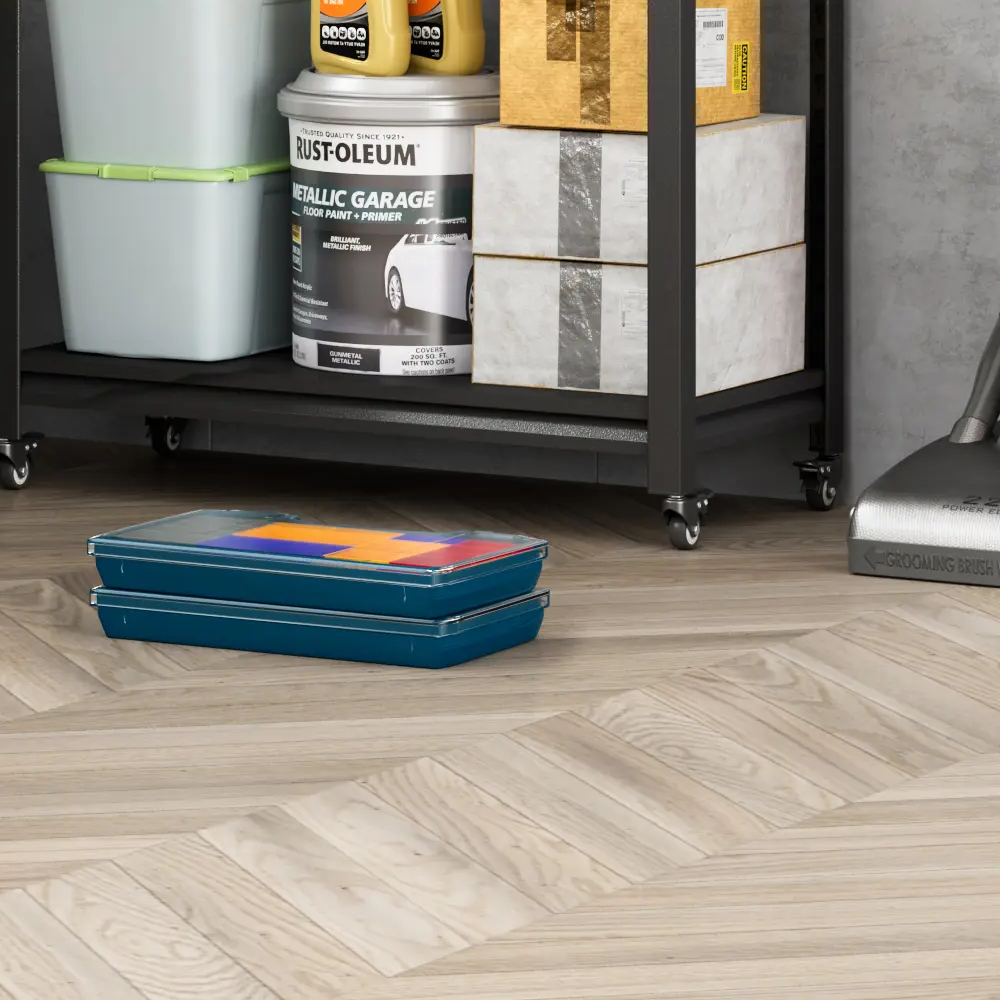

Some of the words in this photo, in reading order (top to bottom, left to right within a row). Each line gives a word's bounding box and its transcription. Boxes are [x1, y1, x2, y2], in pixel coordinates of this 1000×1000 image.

[302, 128, 323, 137] TRUSTED
[325, 131, 354, 139] QUALITY
[296, 136, 416, 166] RUST-OLEUM
[292, 181, 347, 208] METALLIC
[351, 190, 436, 209] GARAGE
[303, 206, 324, 218] FLOOR
[325, 210, 352, 220] PAINT
[361, 211, 402, 222] PRIMER
[330, 235, 361, 245] BRILLIANT,
[322, 241, 349, 251] METALLIC
[349, 244, 371, 252] FINISH
[329, 350, 363, 360] GUNMETAL
[331, 357, 361, 366] METALLIC
[435, 357, 456, 366] COATS
[942, 504, 984, 514] POWER
[885, 551, 955, 573] GROOMING
[959, 558, 994, 577] BRUSH
